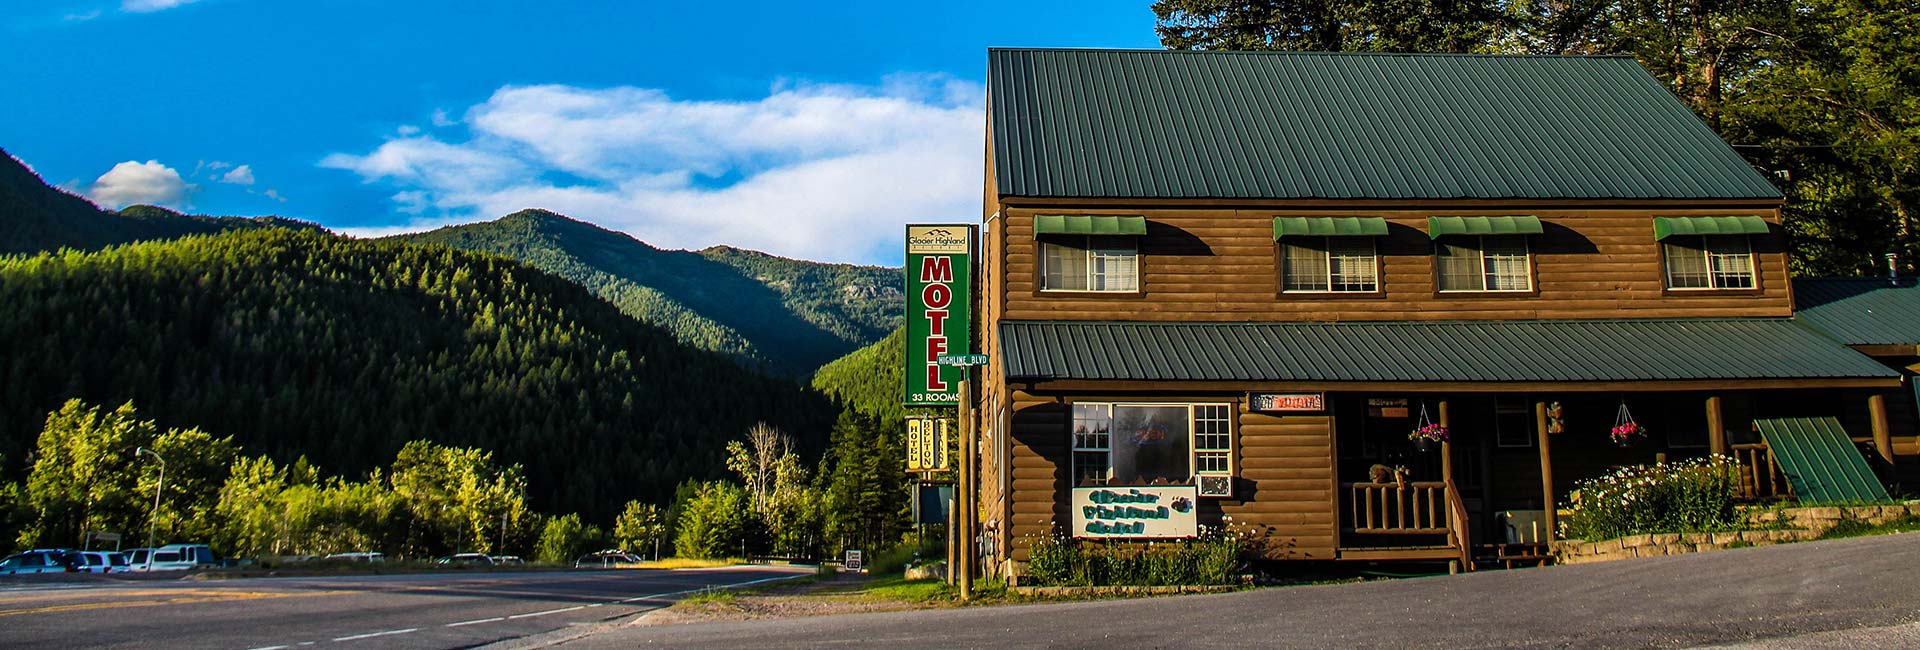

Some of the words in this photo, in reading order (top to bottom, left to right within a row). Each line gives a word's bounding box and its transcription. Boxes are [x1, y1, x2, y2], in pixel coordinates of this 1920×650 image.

[909, 236, 933, 244] Glacier
[935, 236, 966, 247] Highland
[920, 256, 954, 392] MOTEL
[938, 355, 967, 365] HIGHLINE
[971, 355, 987, 364] BLVD
[912, 393, 923, 402] 33
[910, 425, 918, 462] HOTEL
[923, 421, 932, 466] BELTON
